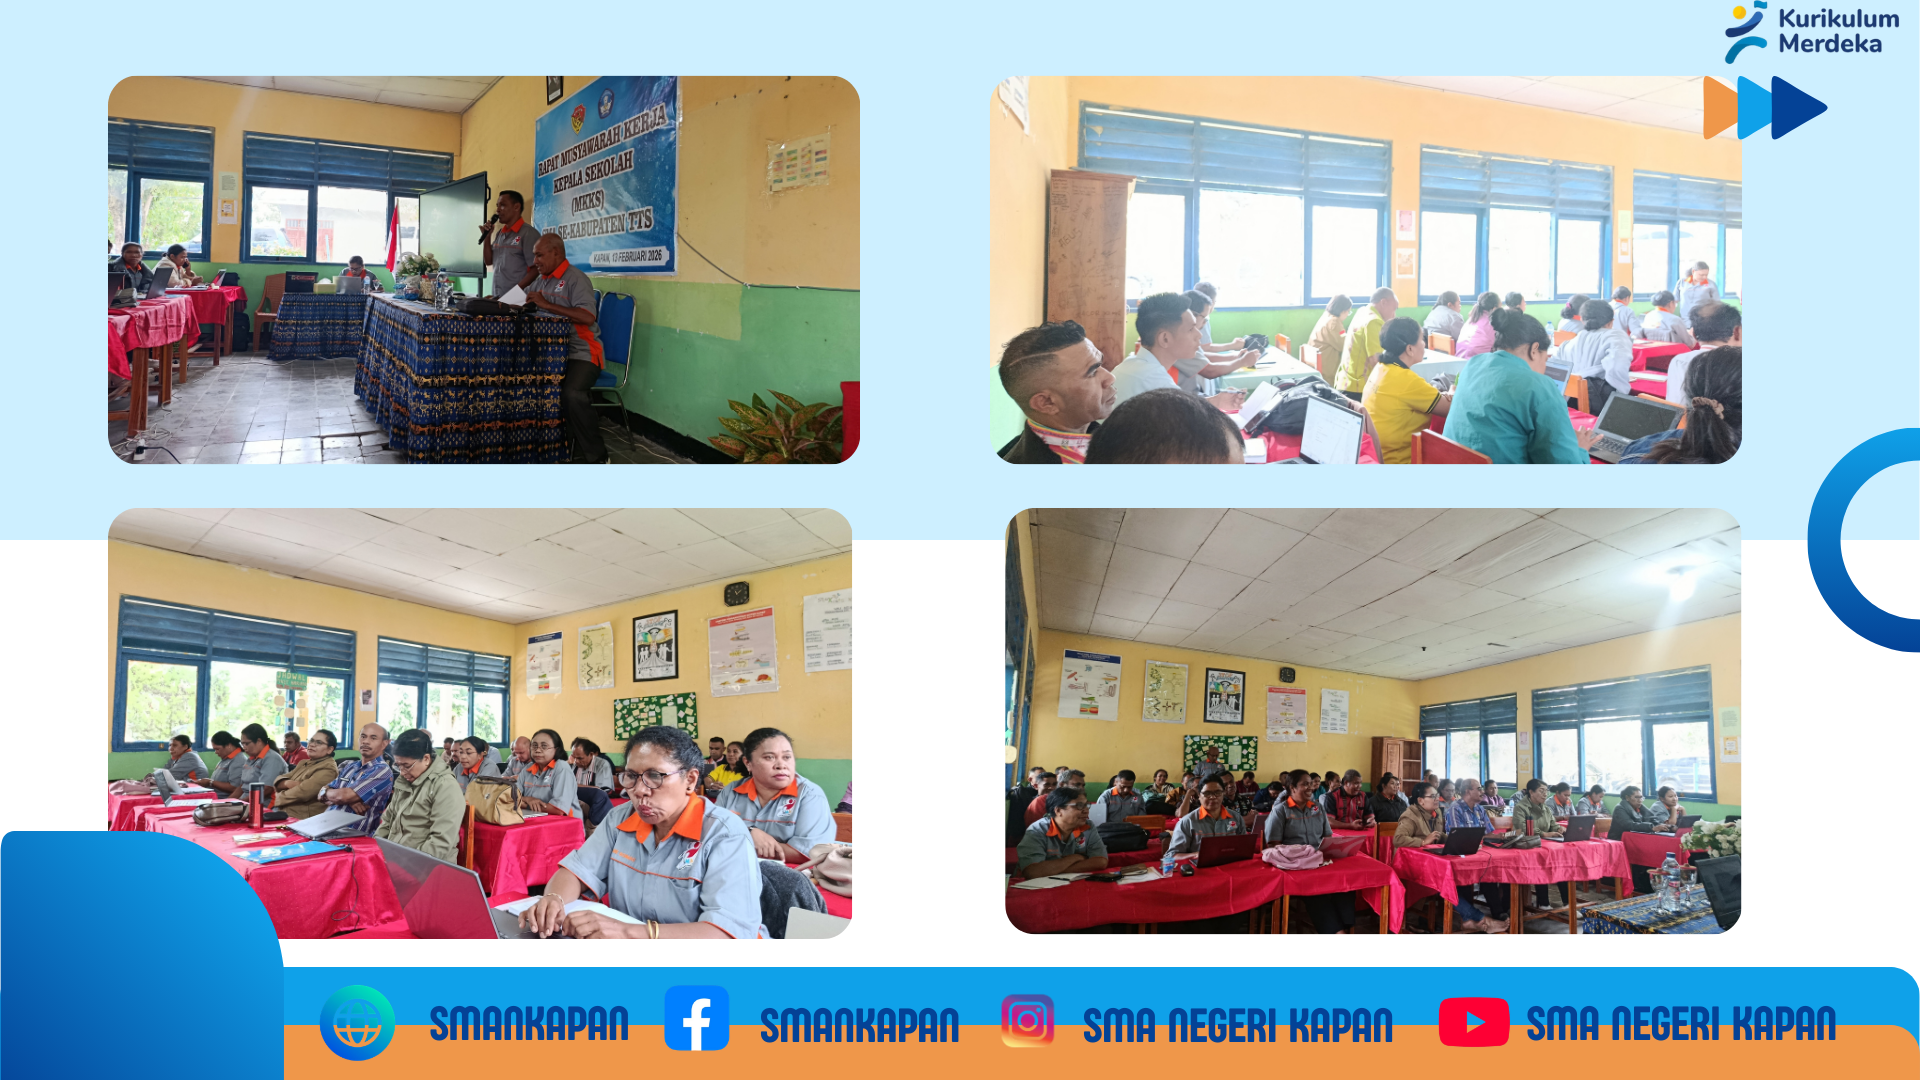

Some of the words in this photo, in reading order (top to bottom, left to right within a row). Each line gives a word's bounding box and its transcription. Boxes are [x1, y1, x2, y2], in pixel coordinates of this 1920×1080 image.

[538, 155, 560, 177] RAPAT
[560, 125, 621, 167] MUSYAWARAH
[623, 104, 667, 140] KERJA
[553, 171, 583, 194] KEPALA
[585, 150, 634, 182] SEKOLAH
[571, 189, 605, 216] (MKKS)
[558, 214, 626, 240] SE-KABUPATEN
[628, 207, 653, 231] TTS
[618, 251, 647, 263] FEBRUARI
[648, 249, 663, 261] 2026
